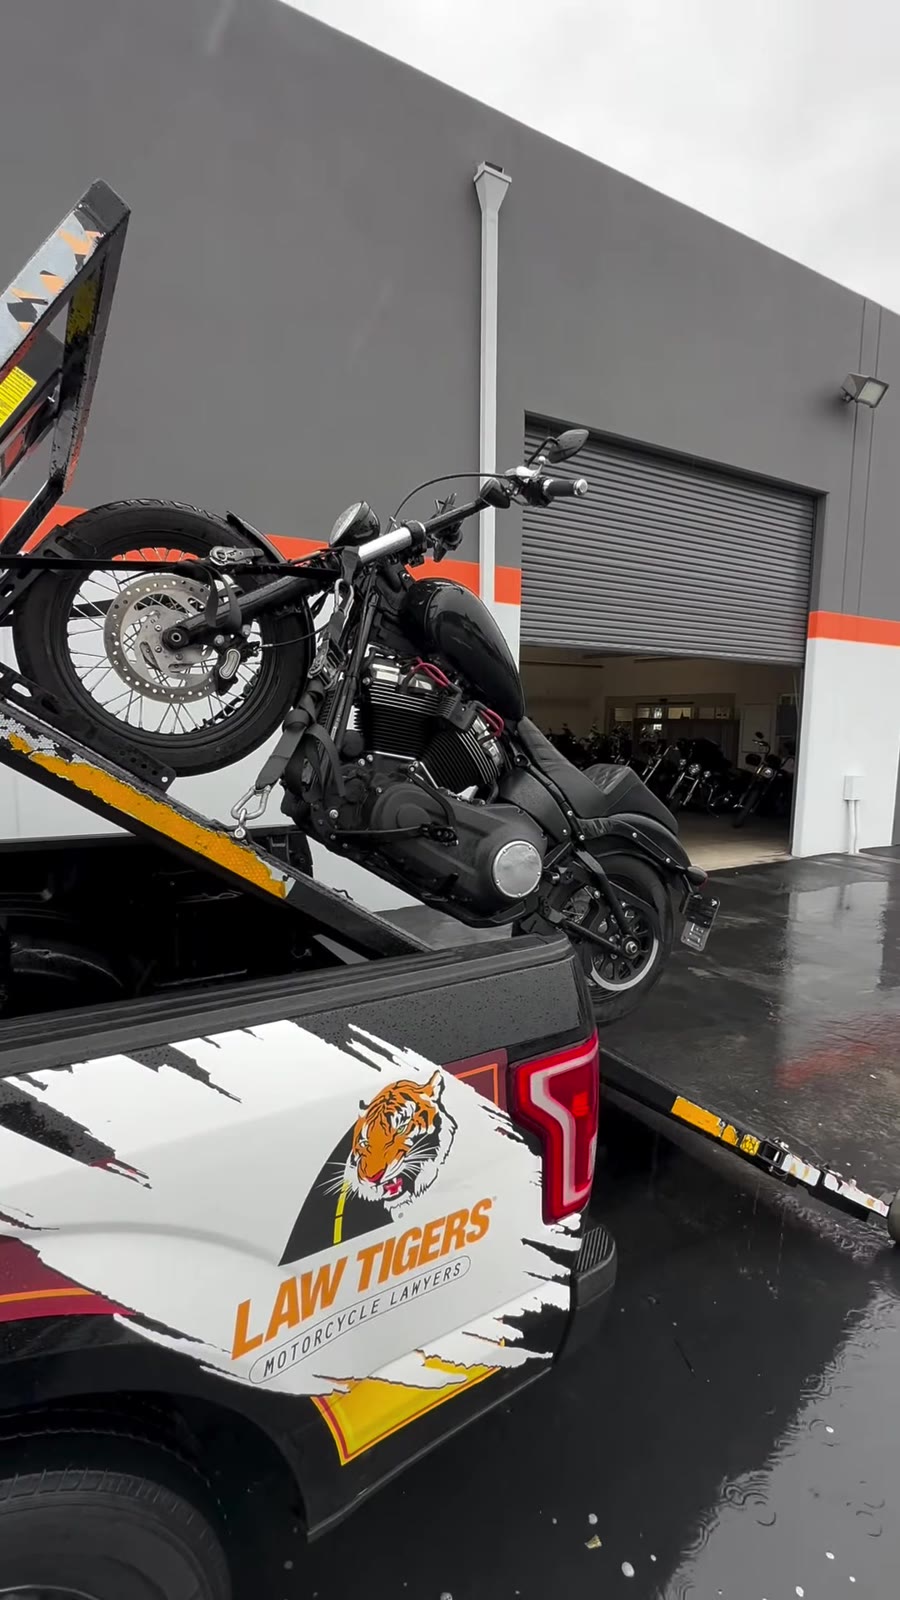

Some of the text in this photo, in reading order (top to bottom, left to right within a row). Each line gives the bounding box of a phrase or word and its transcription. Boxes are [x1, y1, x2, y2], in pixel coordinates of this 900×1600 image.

[231, 1197, 493, 1361] LAW TIGERS
[263, 1262, 461, 1377] MOTORCYCLE LAWYERS
